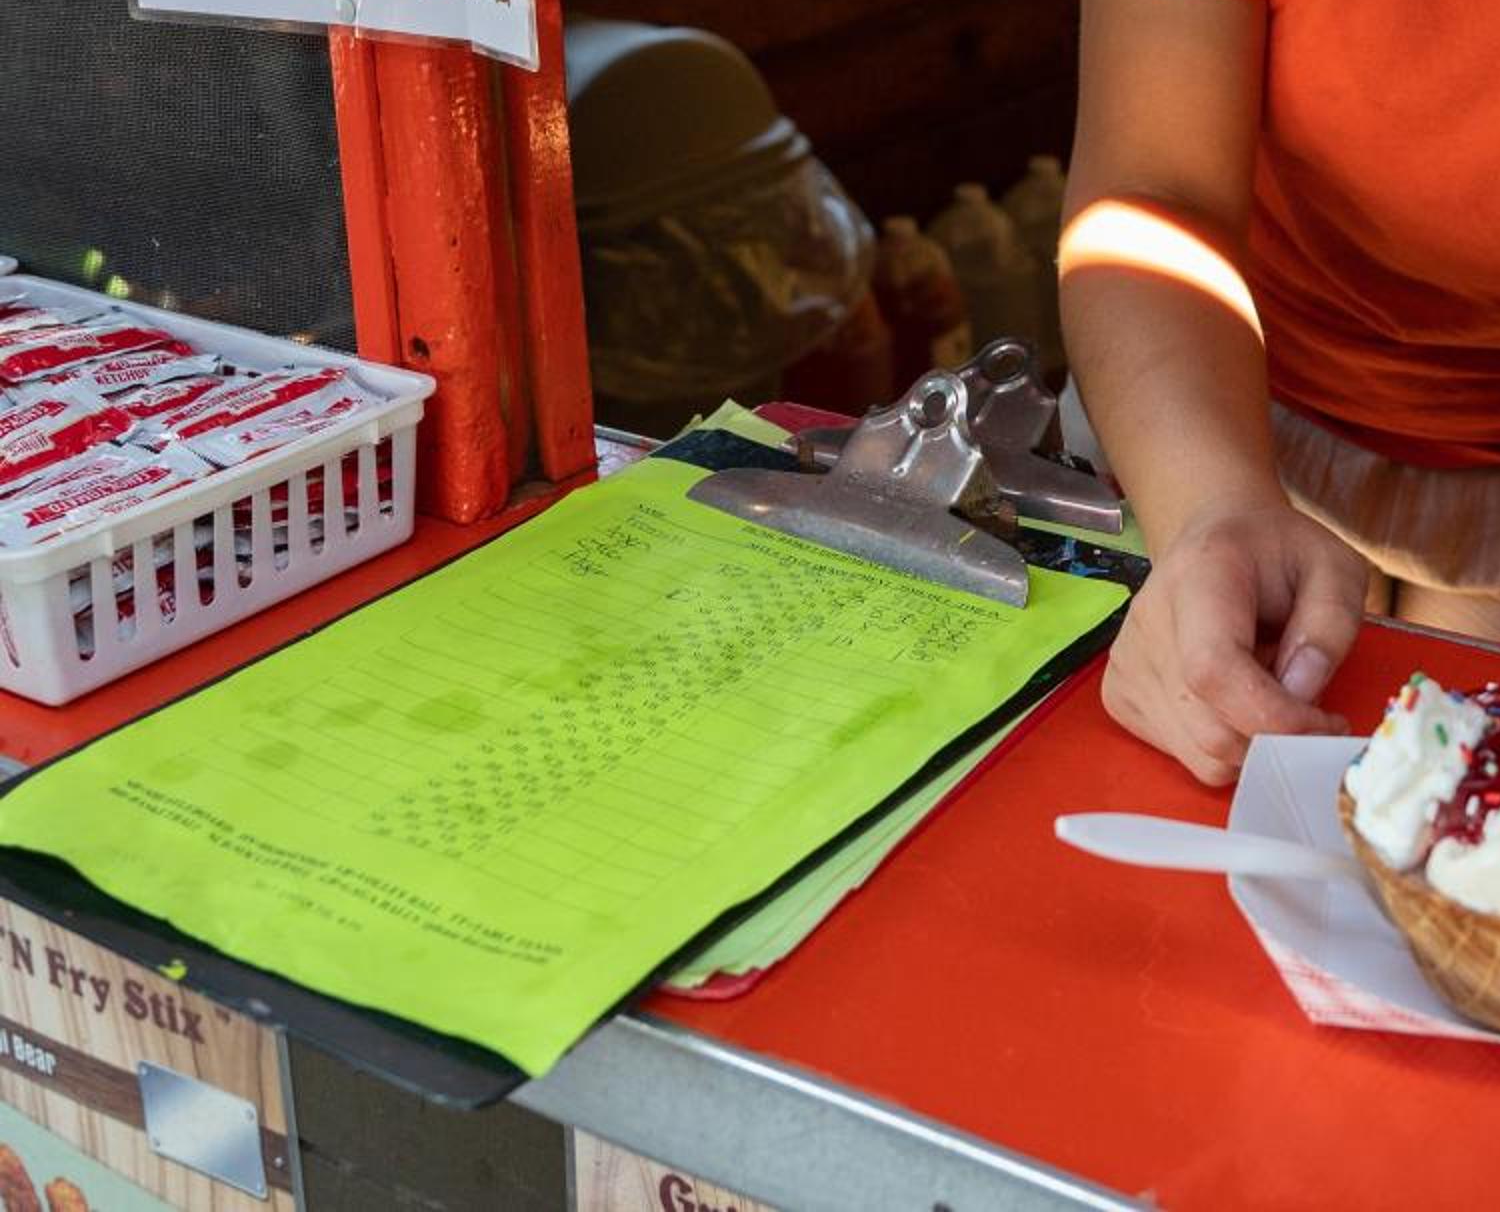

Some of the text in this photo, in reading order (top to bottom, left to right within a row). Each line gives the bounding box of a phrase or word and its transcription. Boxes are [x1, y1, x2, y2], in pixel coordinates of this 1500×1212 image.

[45, 947, 110, 1013] Fry
[124, 978, 205, 1044] Stix
[12, 1034, 57, 1076] Bear
